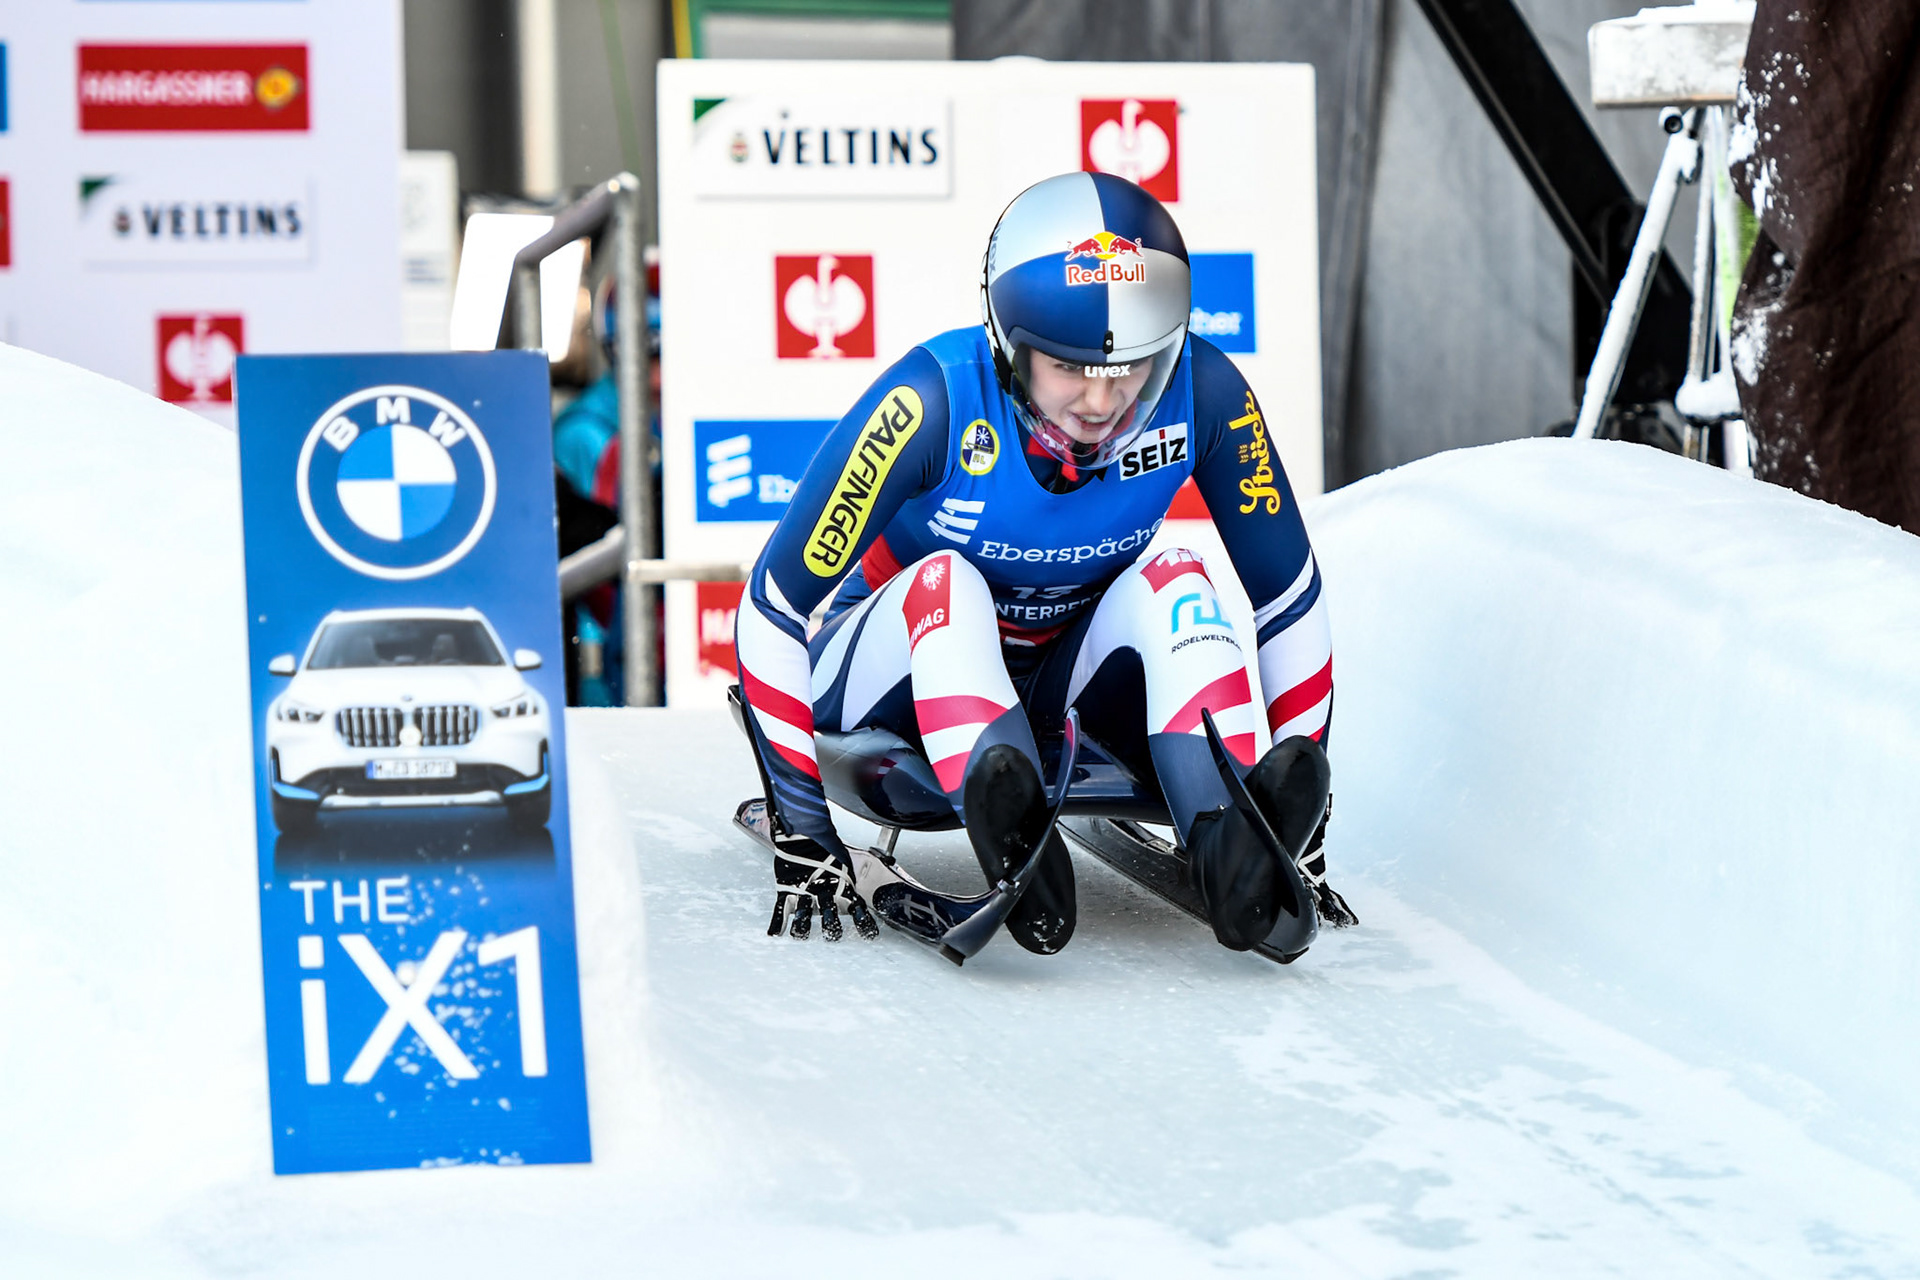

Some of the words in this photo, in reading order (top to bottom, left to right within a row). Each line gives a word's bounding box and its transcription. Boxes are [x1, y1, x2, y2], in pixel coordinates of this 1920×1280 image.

[763, 127, 938, 165] VELTINS
[141, 205, 302, 238] VELTINS
[1066, 263, 1107, 285] Red
[1110, 262, 1146, 283] Bull
[1084, 364, 1131, 378] uvex
[322, 396, 467, 452] BMW
[1228, 390, 1281, 515] Ströck
[810, 395, 915, 568] PALFINGER
[977, 515, 1165, 564] Eberspäche
[289, 877, 409, 925] THE
[298, 925, 548, 1085] iX1
